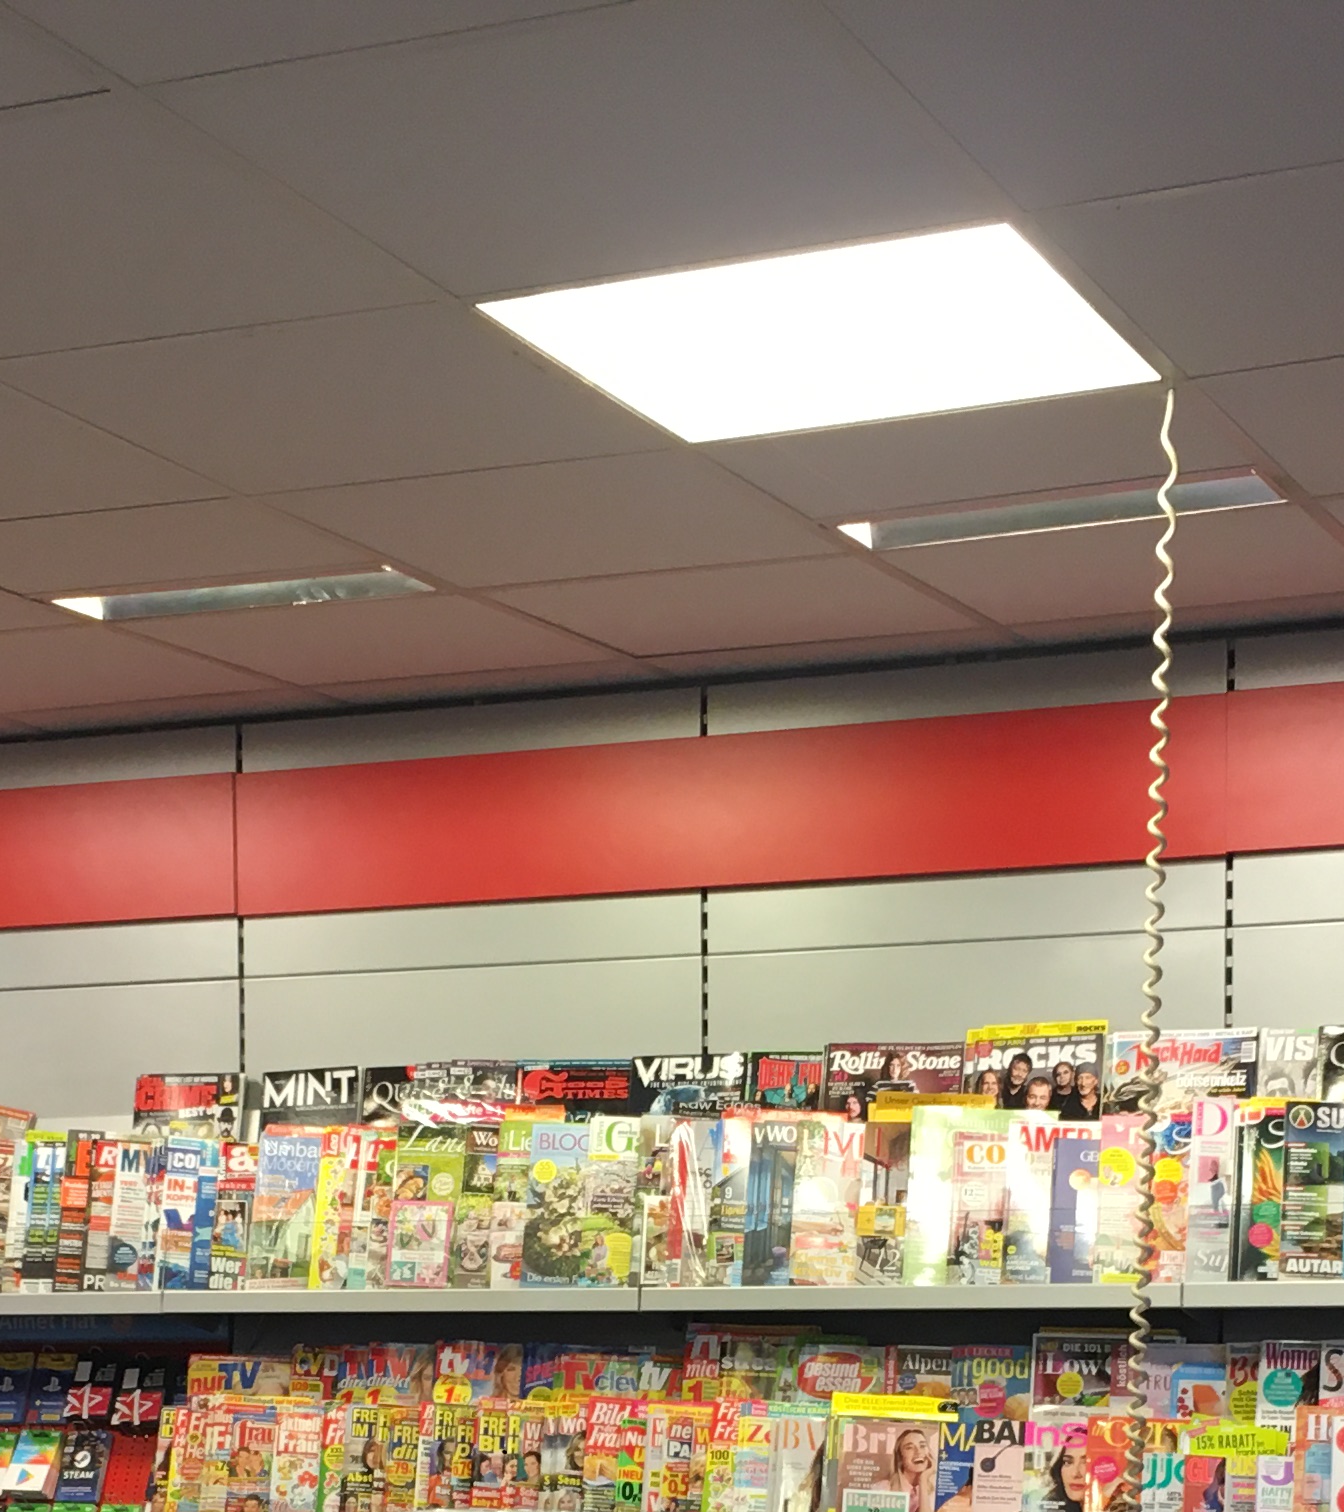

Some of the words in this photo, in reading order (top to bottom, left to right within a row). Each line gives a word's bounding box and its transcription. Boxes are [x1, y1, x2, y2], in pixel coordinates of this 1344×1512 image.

[1076, 1023, 1106, 1035] ROCKS
[905, 1051, 961, 1071] Stone
[977, 1041, 1097, 1070] ROCKS
[1181, 1042, 1222, 1064] Hard
[635, 1052, 746, 1086] VIRUS
[263, 1070, 356, 1108] MINT
[1062, 1343, 1080, 1353] DIE
[1083, 1343, 1102, 1353] 101
[804, 1360, 859, 1384] gesund
[970, 1357, 1030, 1380] good
[1043, 1354, 1102, 1375] Low
[218, 1361, 261, 1391] TV
[816, 1376, 862, 1393] essen
[592, 1403, 628, 1426] Bild
[1196, 1437, 1215, 1451] 15%
[1217, 1433, 1257, 1448] RABATT
[63, 1470, 94, 1482] STEAM
